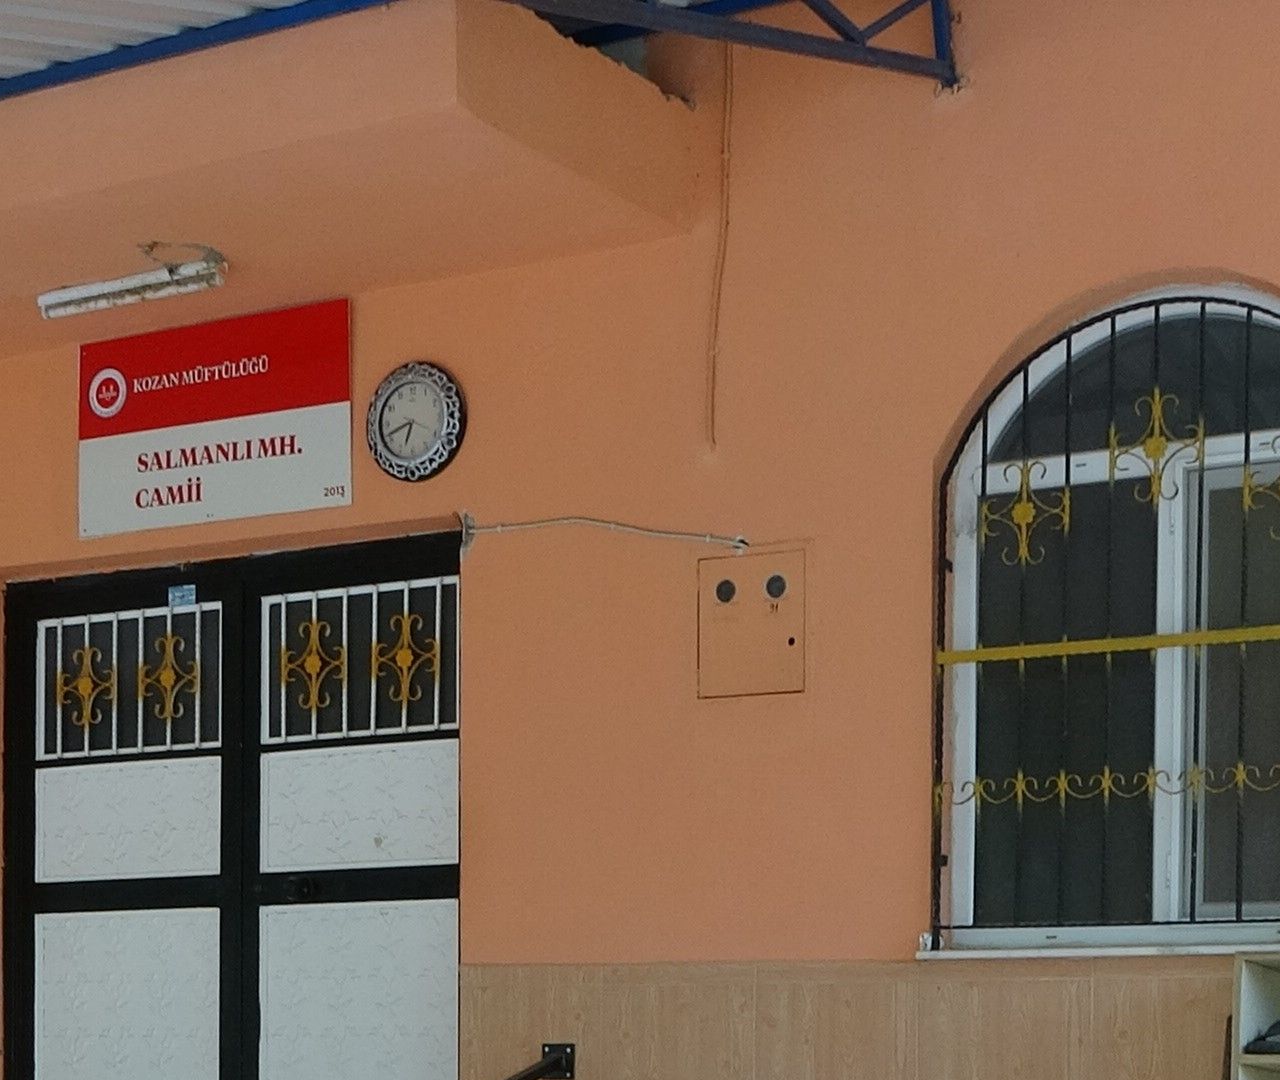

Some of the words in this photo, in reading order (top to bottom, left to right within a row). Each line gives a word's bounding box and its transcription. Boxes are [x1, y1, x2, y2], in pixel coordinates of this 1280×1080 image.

[132, 372, 180, 394] KOZAN
[181, 354, 269, 386] MÜFTÜLÜĞÜ
[136, 440, 253, 474] SALMANLI
[257, 434, 303, 457] MH.
[135, 476, 203, 510] CAMİİ
[323, 485, 346, 498] 2013
